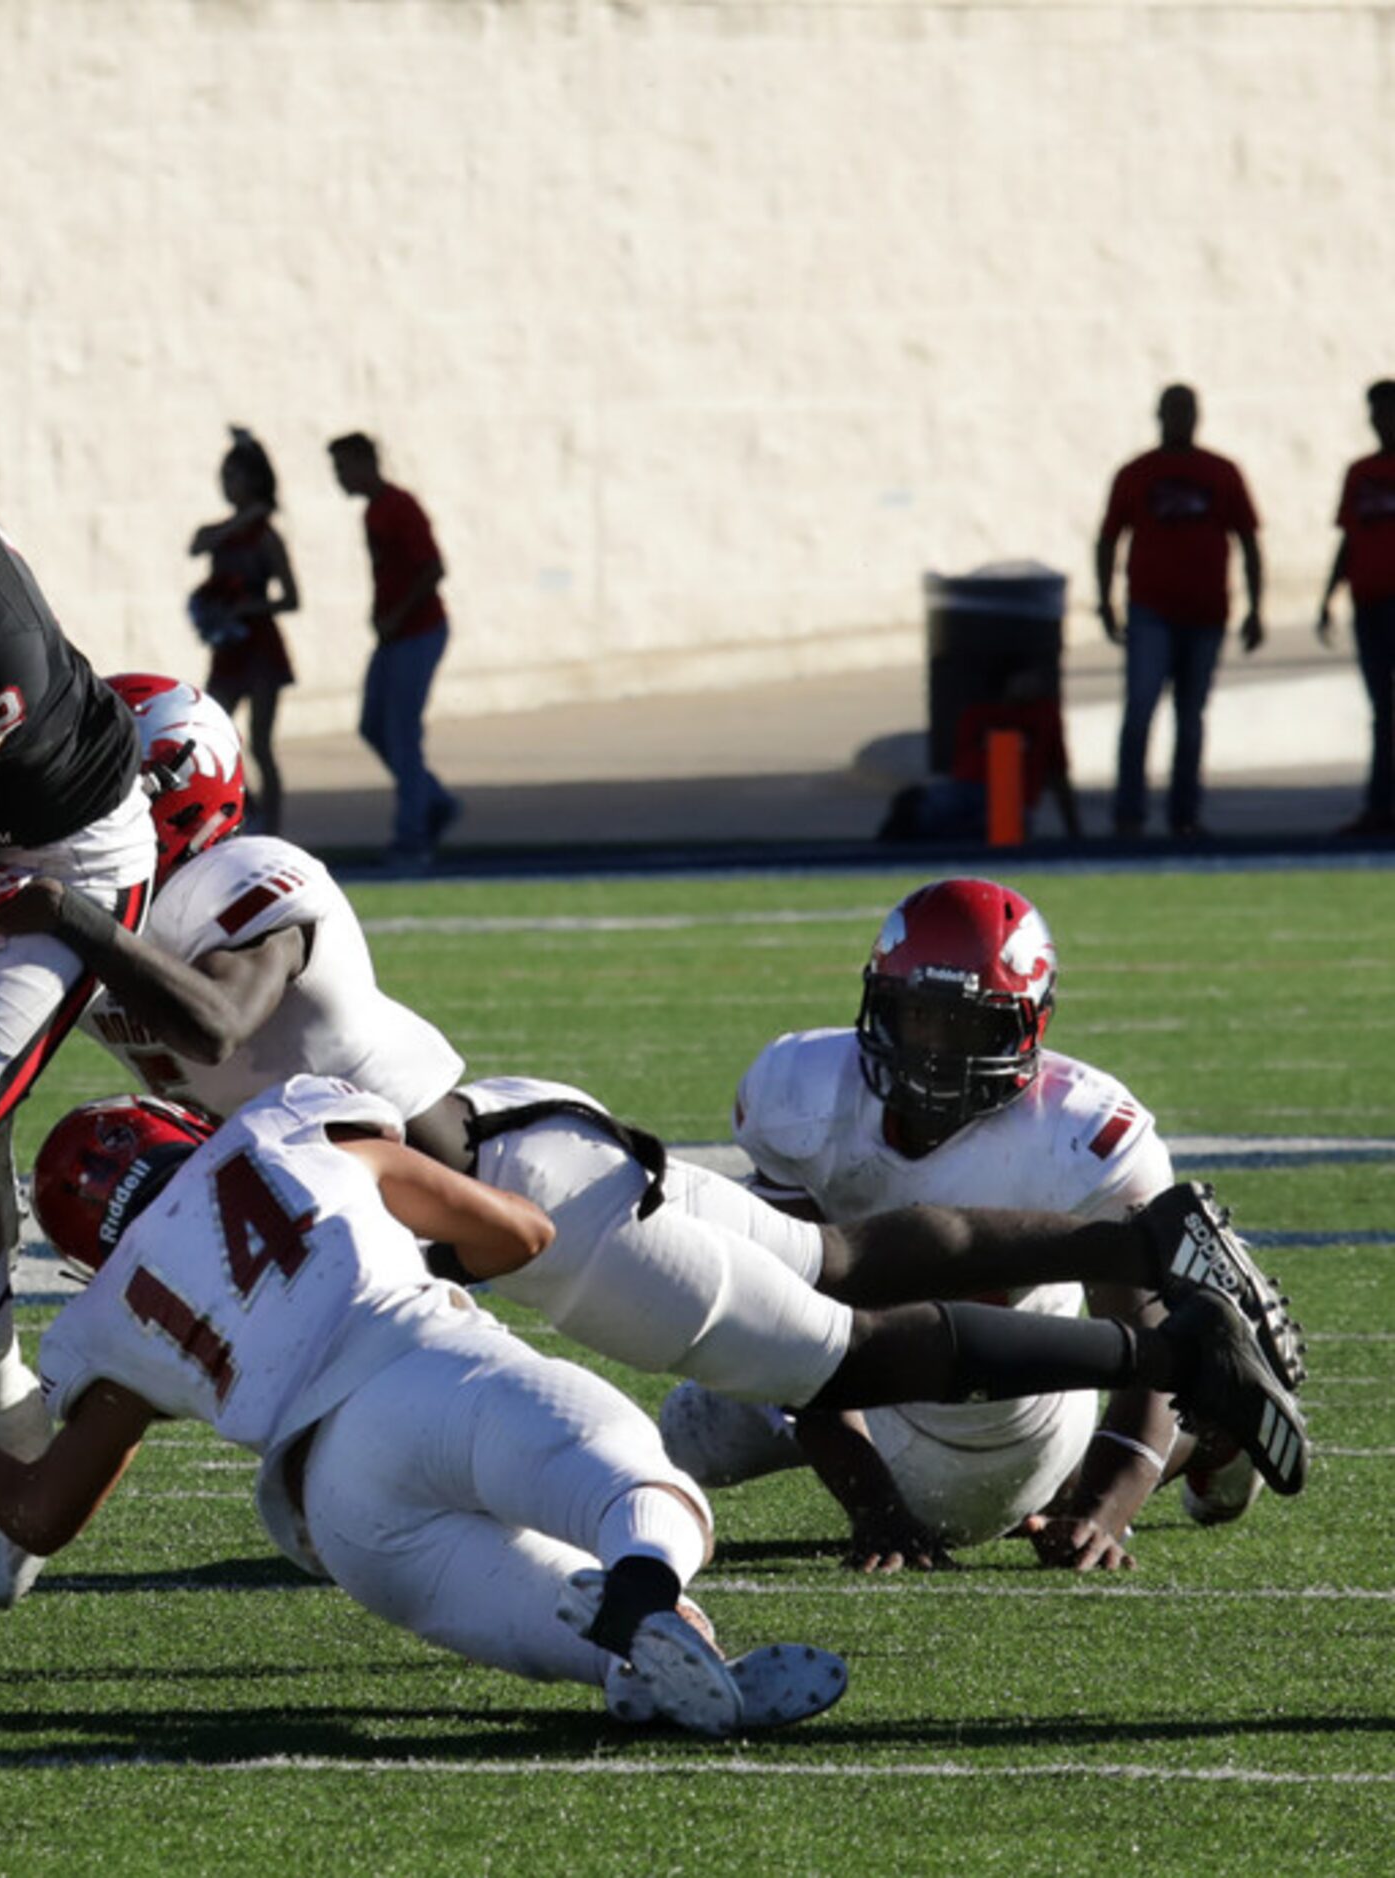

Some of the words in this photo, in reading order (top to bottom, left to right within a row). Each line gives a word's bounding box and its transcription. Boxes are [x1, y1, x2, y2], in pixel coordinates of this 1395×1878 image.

[99, 1159, 152, 1244] Riddell
[122, 1148, 317, 1405] 14
[1184, 1212, 1239, 1291] adidas
